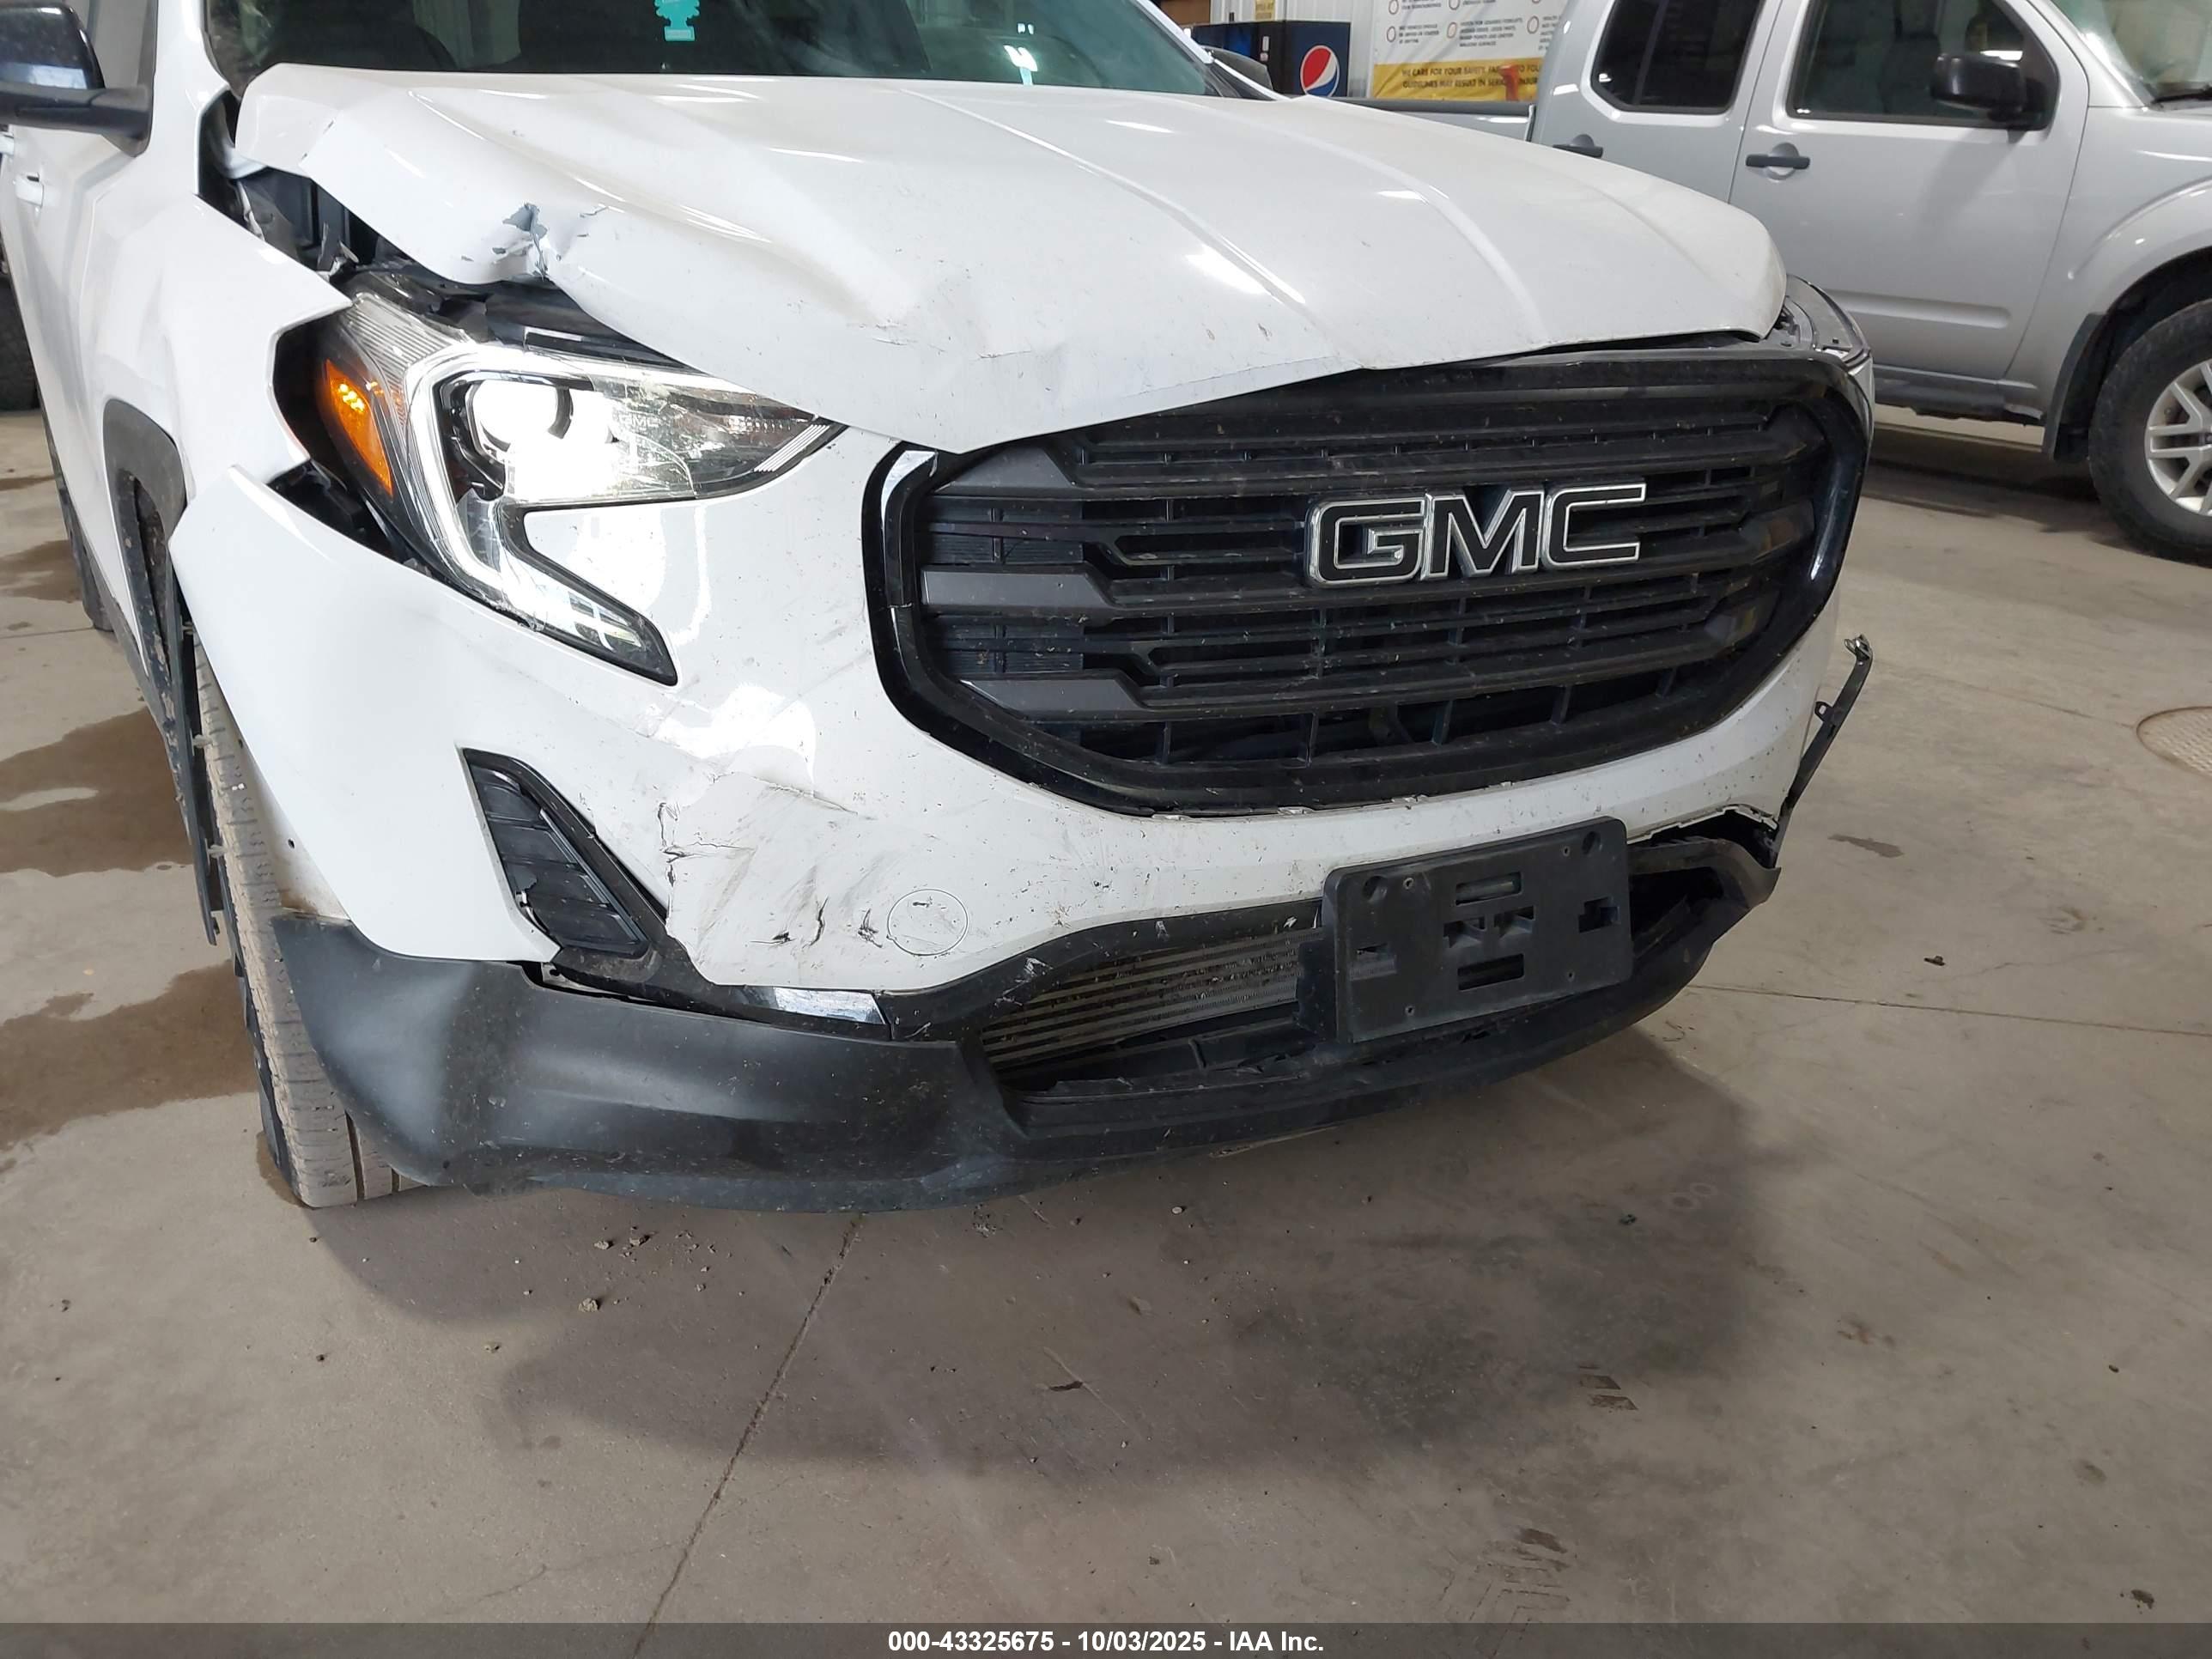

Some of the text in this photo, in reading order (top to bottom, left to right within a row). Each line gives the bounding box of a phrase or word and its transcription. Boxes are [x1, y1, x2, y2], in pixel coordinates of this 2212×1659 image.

[1444, 67, 1462, 76] YOUR
[1478, 78, 1486, 87] IN
[1308, 482, 1647, 584] GMC
